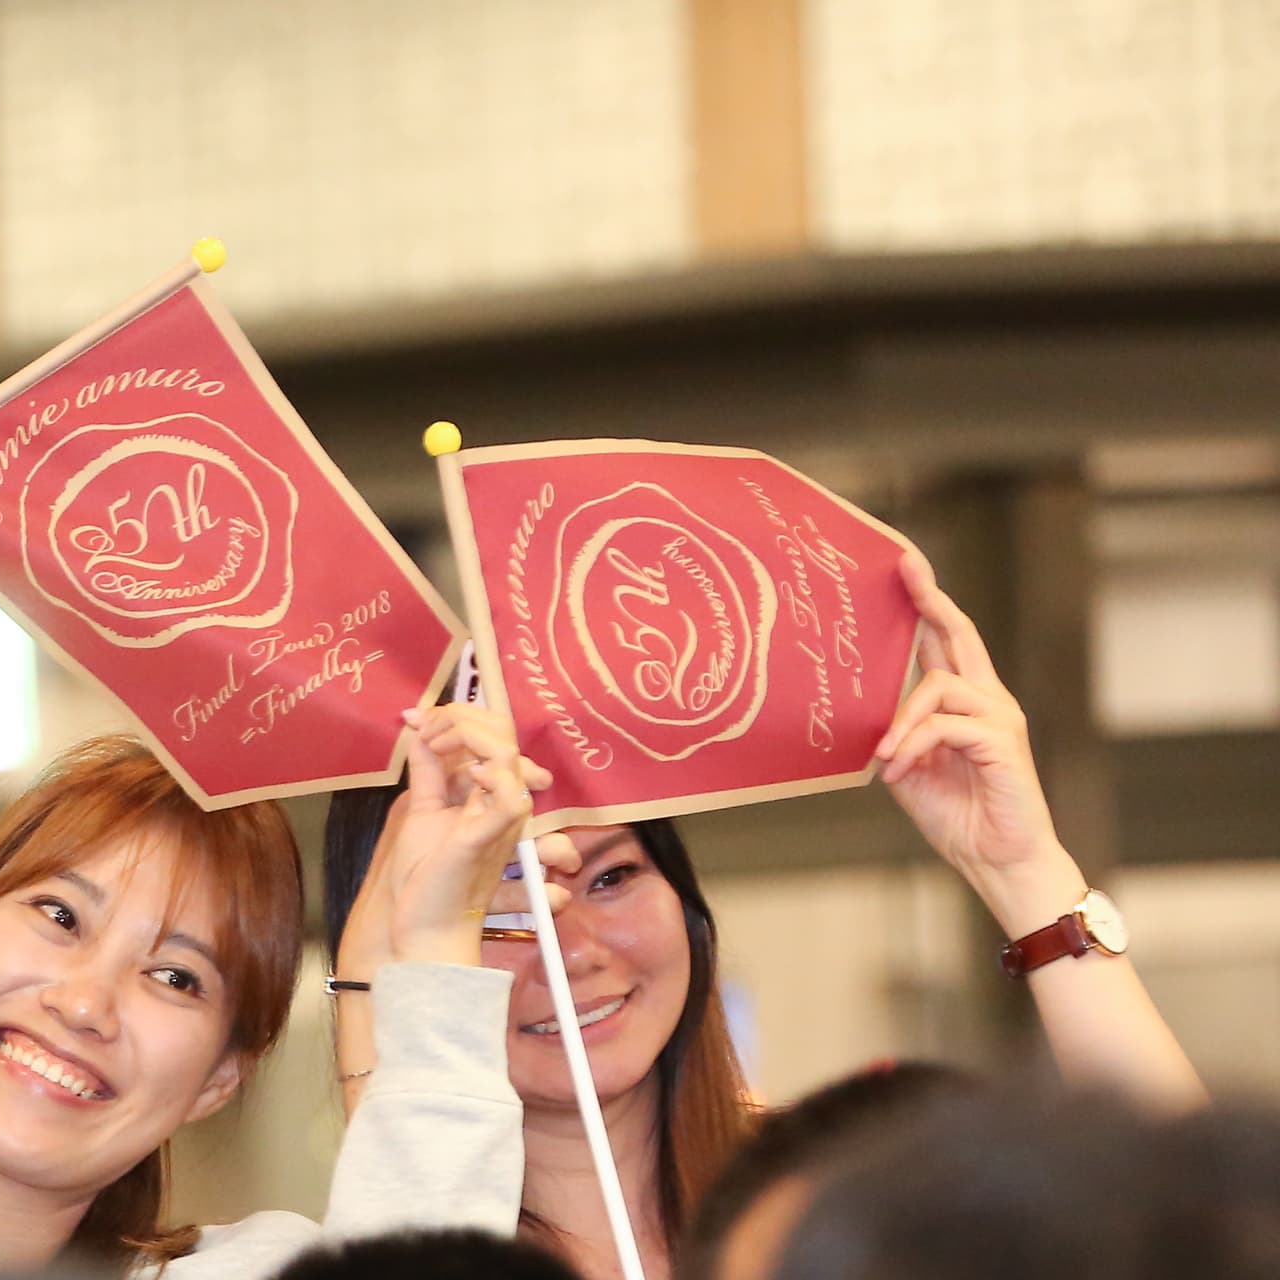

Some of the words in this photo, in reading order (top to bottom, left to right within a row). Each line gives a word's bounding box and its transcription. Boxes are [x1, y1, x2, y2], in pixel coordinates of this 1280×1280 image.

[75, 366, 225, 404] amuro
[69, 462, 220, 573] 25th
[91, 516, 262, 600] Anniversary
[505, 482, 555, 621] amuro
[606, 547, 698, 711] 25th
[663, 536, 737, 712] Anniversary
[777, 534, 821, 638] Tour
[173, 655, 246, 742] Final
[247, 621, 334, 676] Tour
[341, 591, 391, 635] 2018
[797, 640, 836, 752] Final
